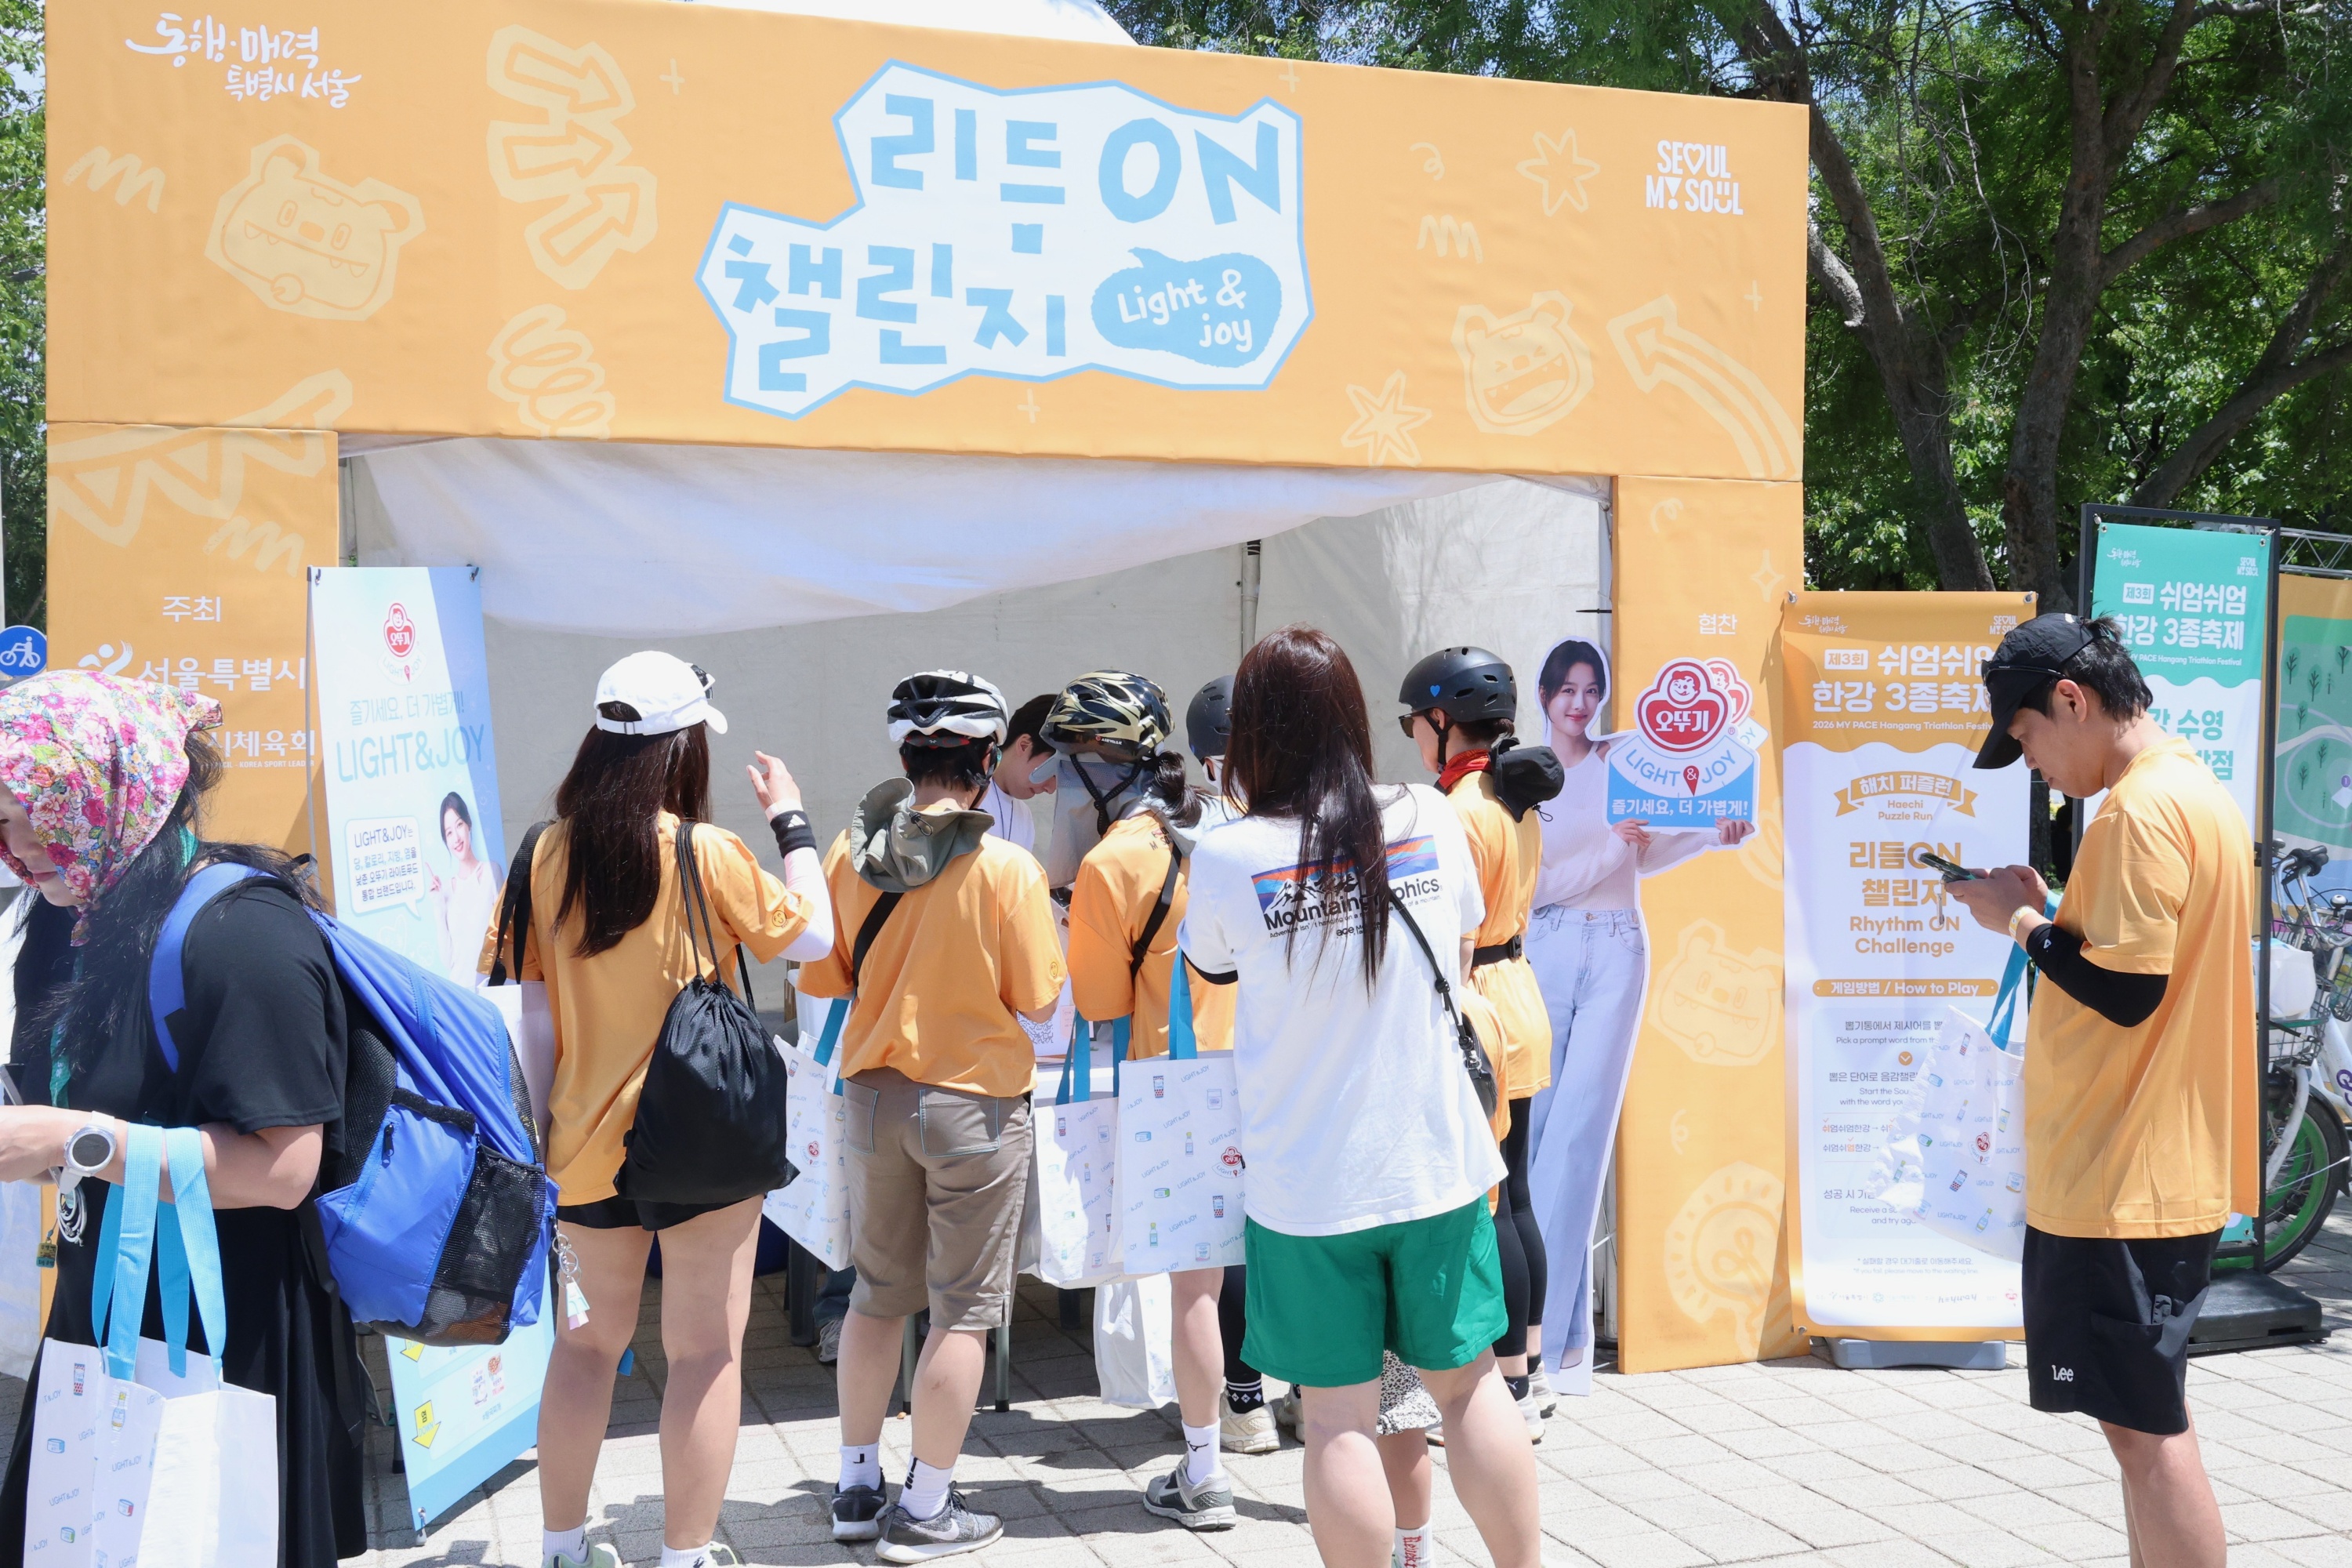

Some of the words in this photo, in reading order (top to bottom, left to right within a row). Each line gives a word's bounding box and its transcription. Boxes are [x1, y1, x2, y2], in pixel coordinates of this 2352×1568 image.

[225, 64, 294, 102] 특별시
[301, 69, 362, 108] 서울
[1117, 281, 1207, 326] Light
[1217, 269, 1247, 310] &
[724, 233, 1066, 392] 챌린지
[1198, 313, 1254, 352] joy
[2125, 586, 2151, 600] 제3회
[2159, 581, 2246, 615] 쉬엄쉬엄
[162, 596, 221, 622] 주최
[1698, 613, 1737, 635] 협찬
[2114, 613, 2158, 646] 한강
[2162, 617, 2245, 651] 3종축제
[390, 632, 410, 646] 오뚜기
[1828, 653, 1864, 666] 제3회
[2158, 655, 2187, 665] Hangang
[138, 658, 305, 691] 서울특별시
[1813, 681, 1877, 713] 한강
[350, 697, 403, 726] 즐기세요,
[406, 695, 420, 718] 더
[422, 691, 465, 717] 가볍게!
[1655, 710, 1709, 732] 오뚜기
[1813, 720, 1835, 729] 2026
[1836, 720, 1851, 729] MY
[1853, 720, 1878, 729] PACE
[1880, 720, 1922, 731] Hangang
[1923, 721, 1965, 730] Triathlon
[2177, 710, 2223, 740] 수영
[336, 724, 484, 782] LIGHT&JOY
[1624, 749, 1680, 786] LIGHT
[1686, 768, 1697, 780] &
[1700, 749, 1737, 784] JOY
[1860, 775, 1894, 794] 해치
[1900, 775, 1953, 796] 퍼즐런
[1612, 799, 1675, 816] 즐기세요,
[1679, 800, 1693, 815] 더
[1697, 799, 1748, 817] 가볍게!
[1888, 800, 1923, 808] Haechi
[1878, 811, 1911, 820] Puzzle
[1914, 811, 1933, 820] Run
[1849, 841, 1962, 869] 리듬ON
[369, 868, 387, 883] 오뚜기
[1862, 879, 1947, 906] 챌린지
[1849, 916, 1923, 935] Rhythm
[1929, 916, 1959, 931] ON
[1855, 938, 1955, 957] Challenge
[1831, 982, 1880, 995] 게임방법
[1894, 982, 1926, 994] How
[1930, 982, 1944, 994] to
[1948, 982, 1980, 996] Play
[1845, 1021, 1892, 1031] 뽑기통에서
[1894, 1021, 1932, 1031] 제시어를
[1860, 1037, 1887, 1047] prompt
[1181, 1065, 1210, 1083] LIGHT&JOY
[1829, 1073, 1847, 1082] 뽑은
[1849, 1073, 1878, 1082] 단어로
[1163, 1109, 1191, 1129] LIGHT&JOY
[1208, 1127, 1238, 1145] LIGHT&JOY
[1822, 1124, 1870, 1133] 쉬엄쉬엄한강
[1142, 1159, 1170, 1178] LIGHT&JOY
[1216, 1165, 1232, 1175] LIGHT
[1177, 1171, 1206, 1189] LIGHT&JOY
[1824, 1189, 1842, 1199] 성공
[1846, 1189, 1855, 1199] 시
[1169, 1214, 1198, 1232] LIGHT&JOY
[1889, 1217, 1900, 1225] try
[2052, 1364, 2074, 1382] Lee
[112, 1455, 142, 1472] LIGHT&JOY
